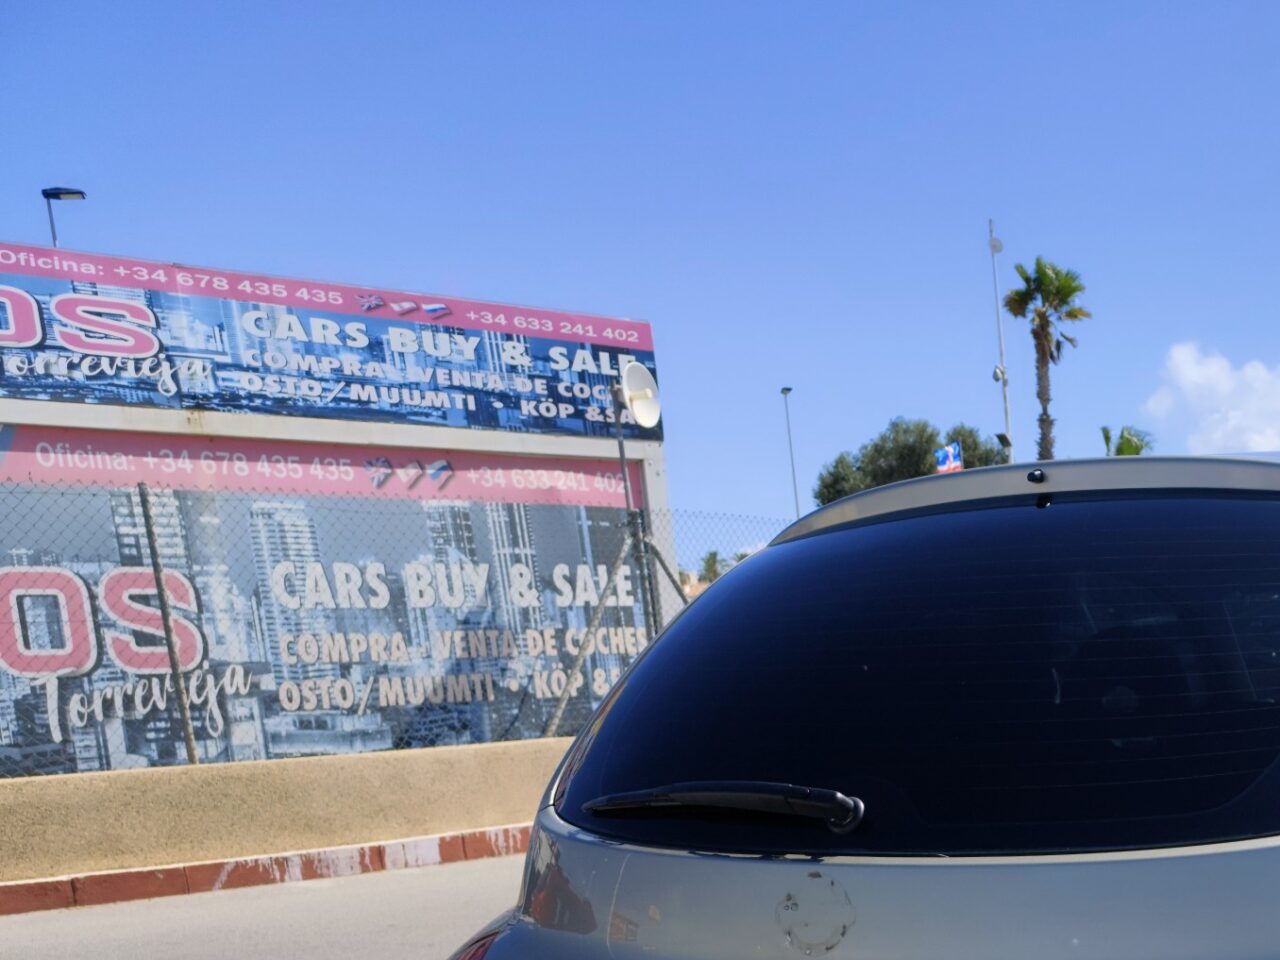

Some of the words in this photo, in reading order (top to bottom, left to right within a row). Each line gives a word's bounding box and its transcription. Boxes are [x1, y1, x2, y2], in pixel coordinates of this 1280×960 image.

[0, 249, 105, 276] Oficina:
[113, 265, 169, 285] +34
[176, 272, 230, 291] 678
[237, 280, 288, 299] 435
[295, 287, 344, 305] 435
[241, 309, 370, 349] CARS
[388, 326, 481, 361] BUY
[501, 340, 533, 367] &
[465, 310, 507, 328] +34
[514, 316, 555, 333] 633
[560, 321, 598, 338] 241
[602, 326, 640, 343] 402
[7, 352, 212, 397] orrevieja
[245, 351, 387, 378] COMPRA
[414, 366, 505, 393] VENTA
[513, 376, 549, 397] DE
[557, 381, 613, 402] COC
[520, 397, 576, 419] KÖP
[36, 442, 136, 472] Oficina:
[144, 449, 194, 475] +34
[201, 451, 250, 477] 678
[257, 455, 304, 479] 435
[310, 457, 355, 481] 435
[467, 466, 507, 488] +34
[511, 468, 551, 489] 633
[554, 471, 590, 491] 241
[594, 473, 626, 493] 402
[271, 561, 390, 609] CARS
[405, 561, 491, 608] BUY
[510, 564, 542, 608] &
[553, 562, 635, 608] SALE
[278, 631, 411, 666] COMPRA
[432, 629, 519, 662] VENTA
[527, 628, 558, 657] DE
[534, 661, 584, 698] KÖP
[30, 660, 252, 743] Torreveja
